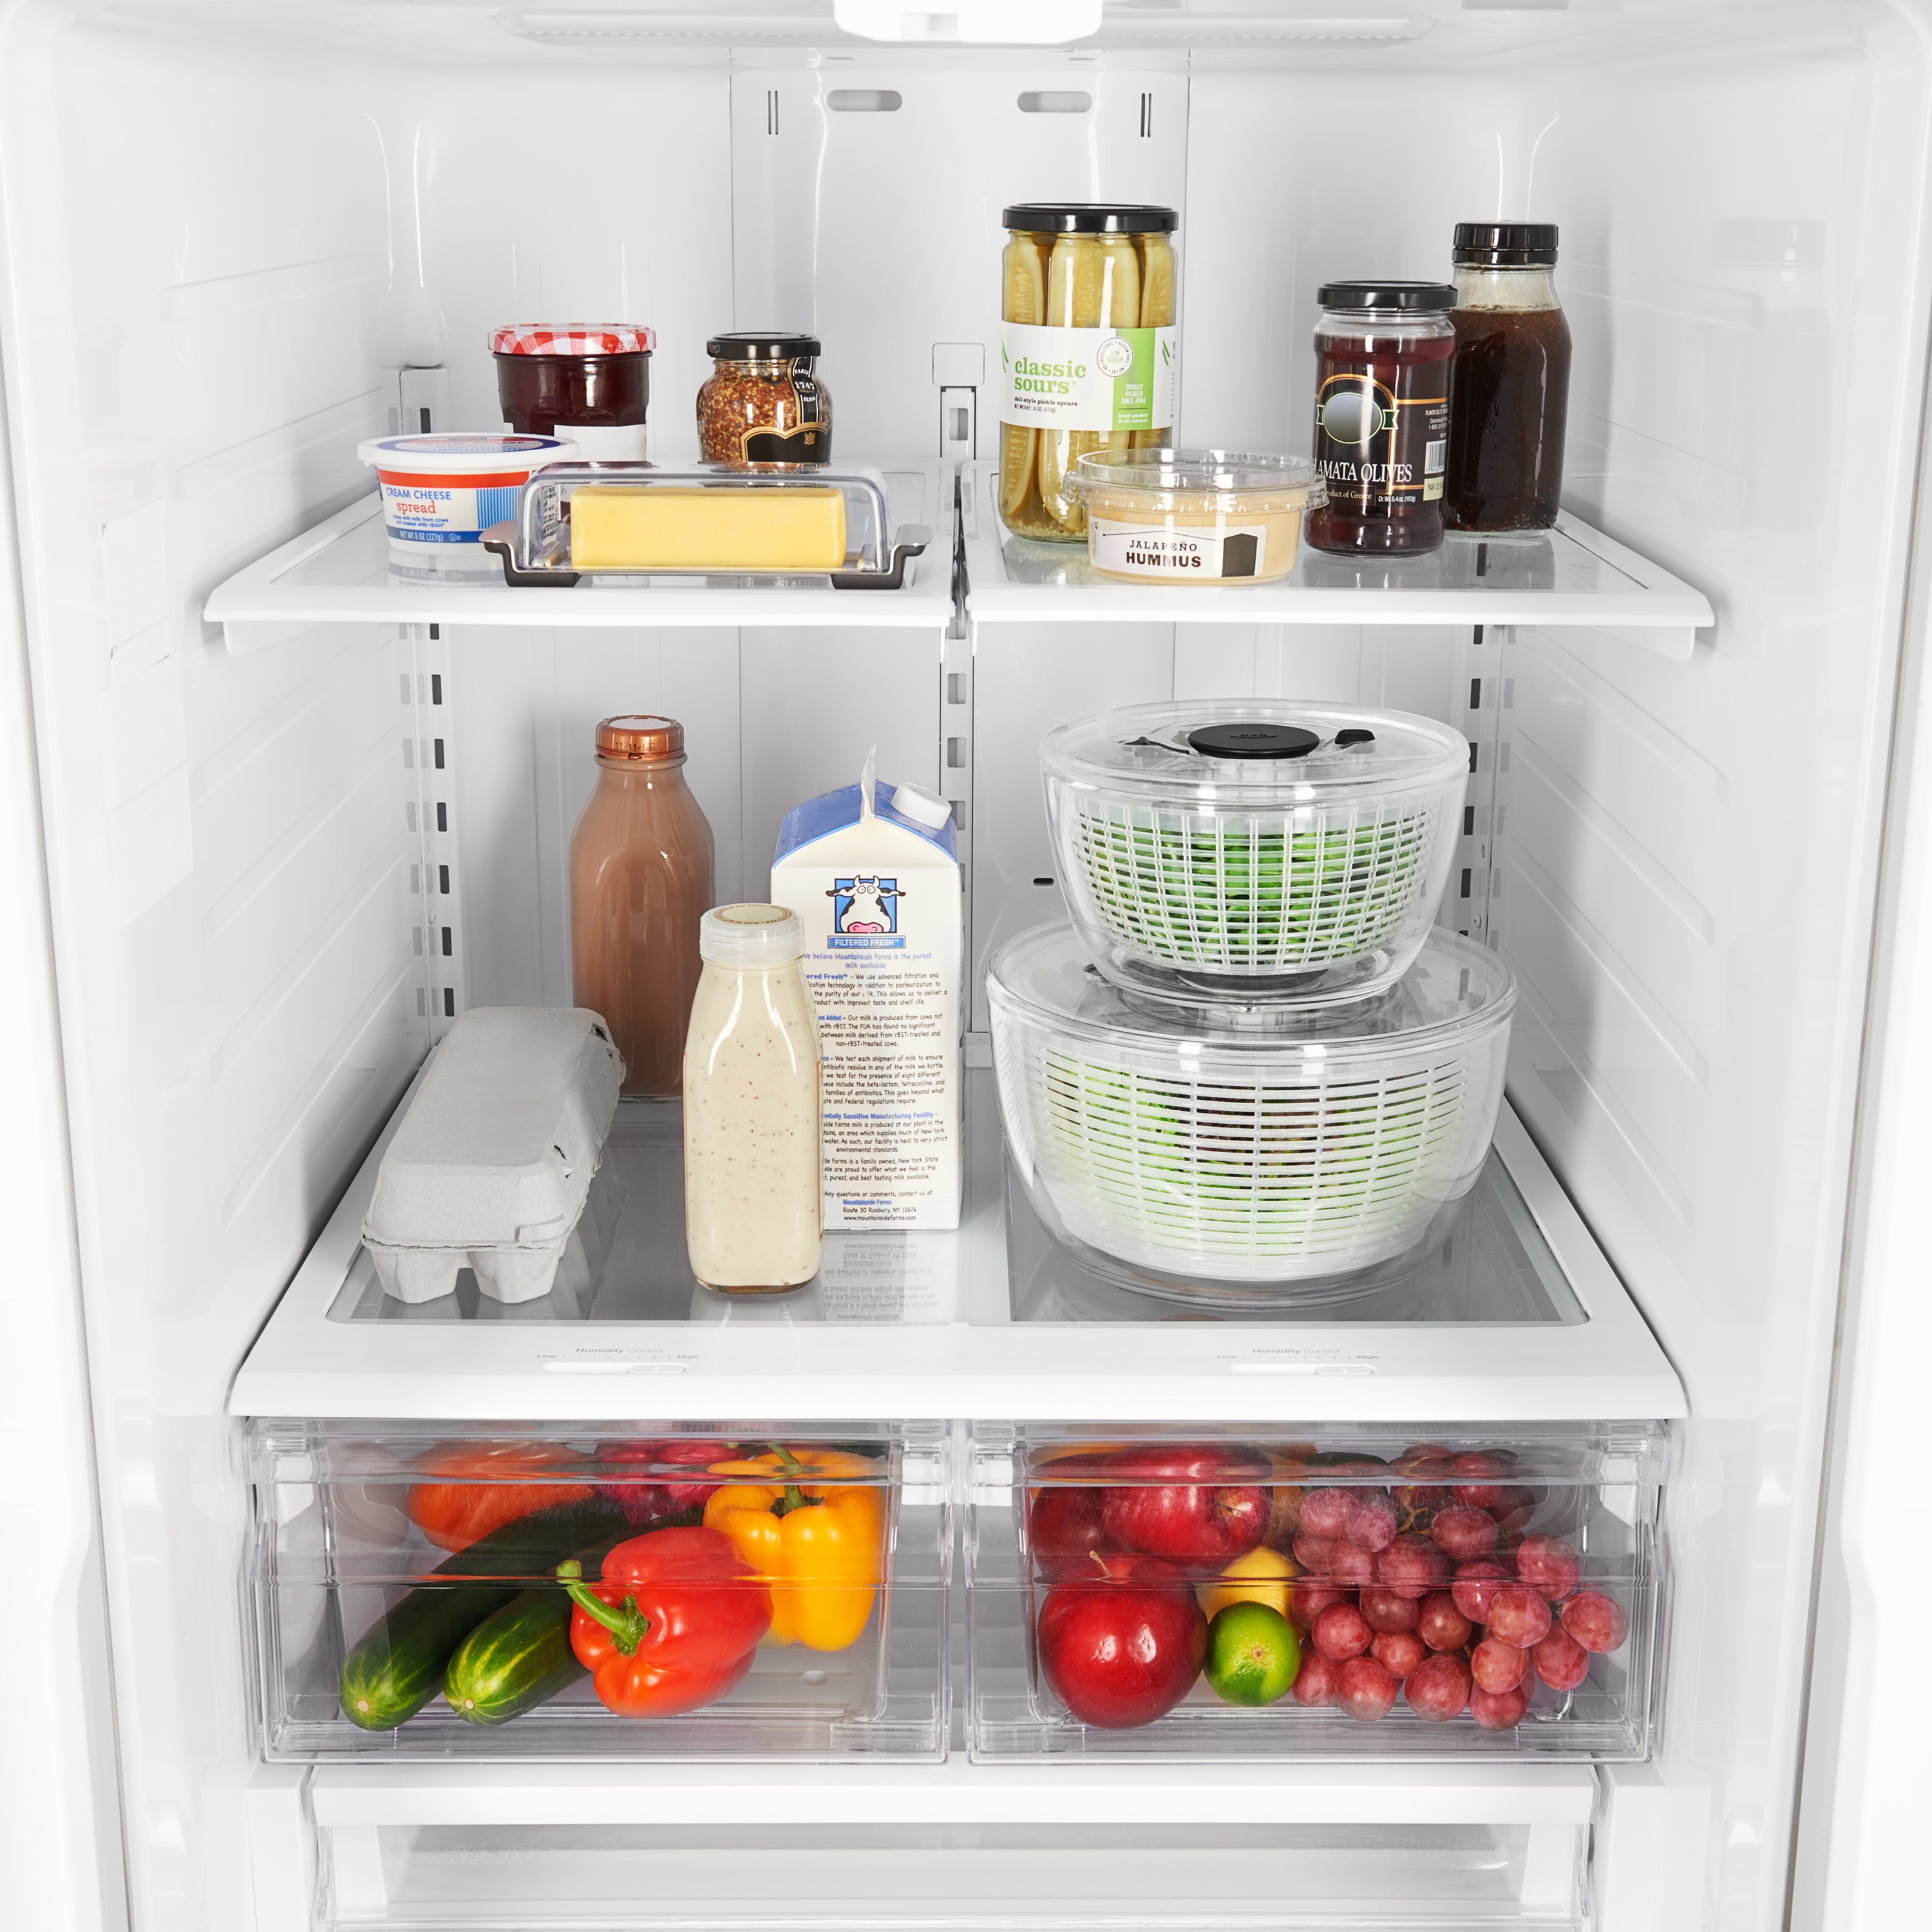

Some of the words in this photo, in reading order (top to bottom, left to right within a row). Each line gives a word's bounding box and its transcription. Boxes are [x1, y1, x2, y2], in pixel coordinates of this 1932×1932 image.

[1118, 341, 1129, 352] GLUTEN
[1015, 357, 1086, 378] classic
[795, 382, 814, 390] 1747
[1361, 463, 1412, 482] OLIVES
[386, 487, 410, 498] CREAM
[414, 490, 451, 500] CHEESE
[1350, 491, 1372, 499] Greece
[397, 501, 436, 514] spread
[426, 533, 443, 542] (227g)
[1130, 540, 1197, 551] JALAPEÑO
[1126, 552, 1201, 567] HUMMUS
